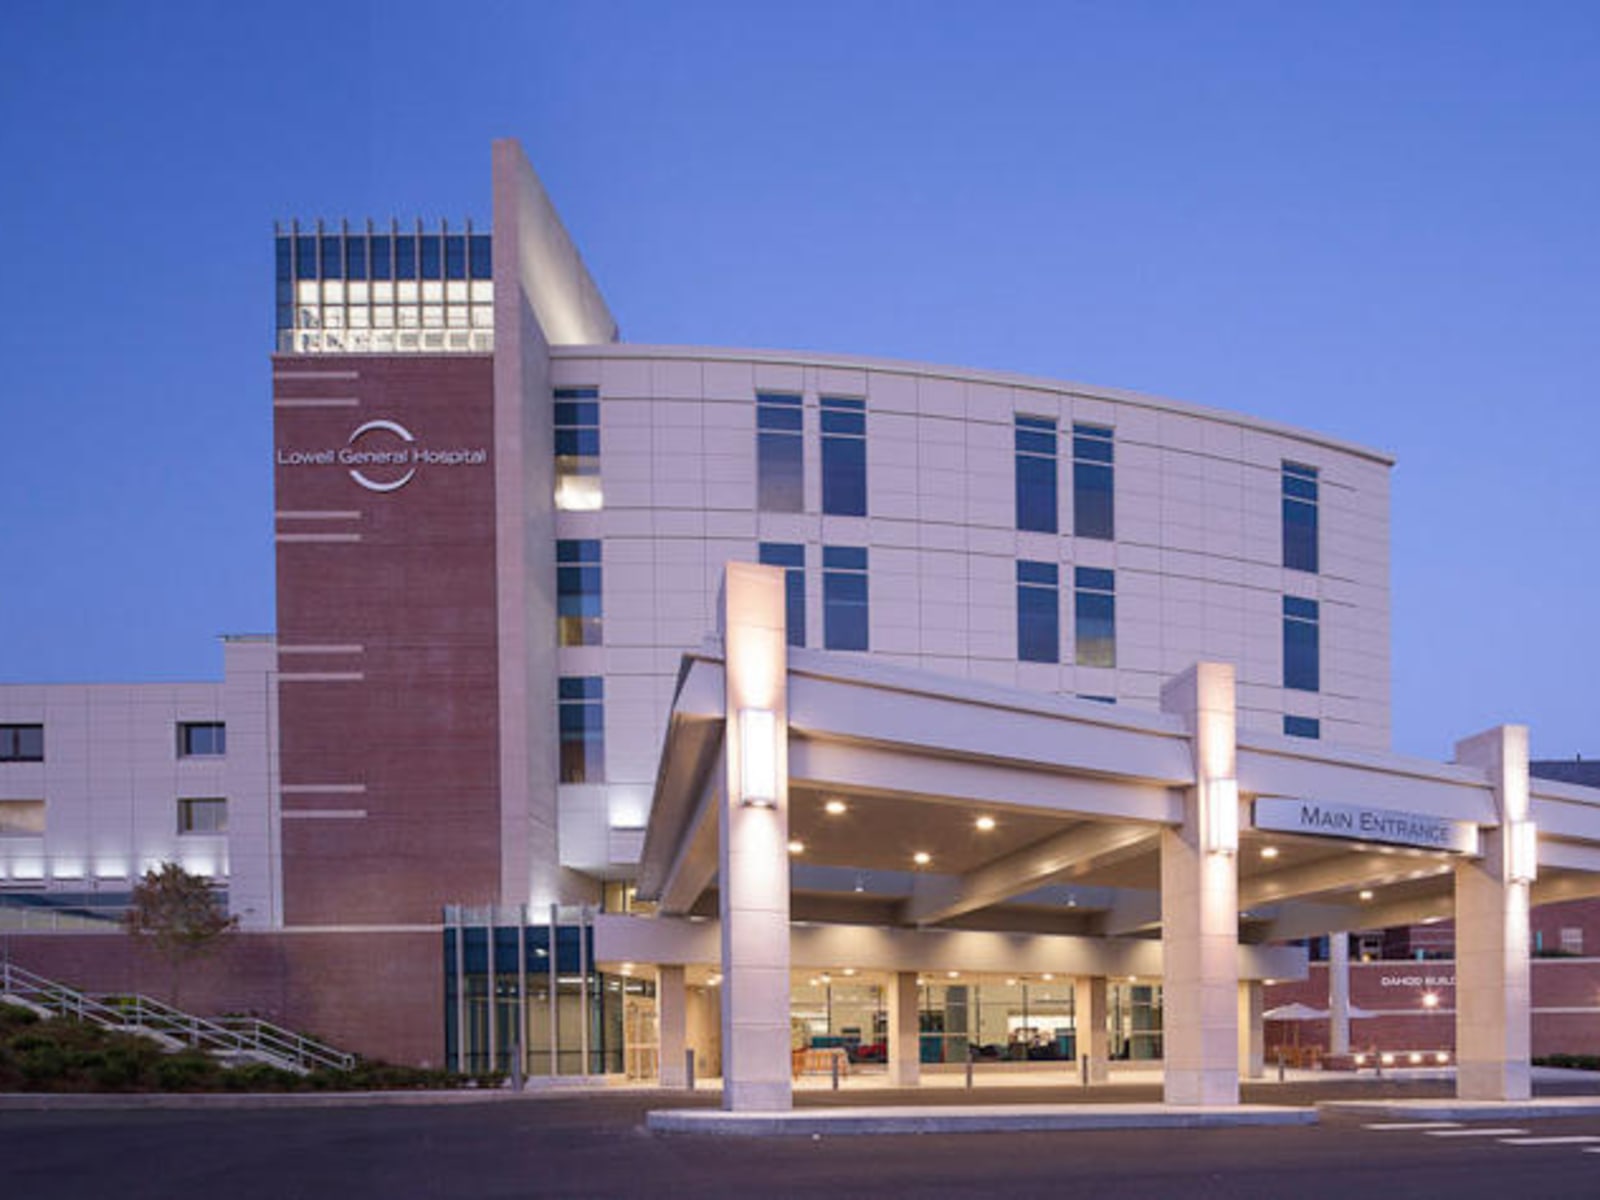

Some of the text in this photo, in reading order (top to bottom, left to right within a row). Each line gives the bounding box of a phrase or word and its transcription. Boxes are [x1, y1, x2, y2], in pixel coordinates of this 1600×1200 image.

[277, 449, 486, 466] Lowell General Hospital
[1301, 806, 1448, 841] MAIN ENTRANCE
